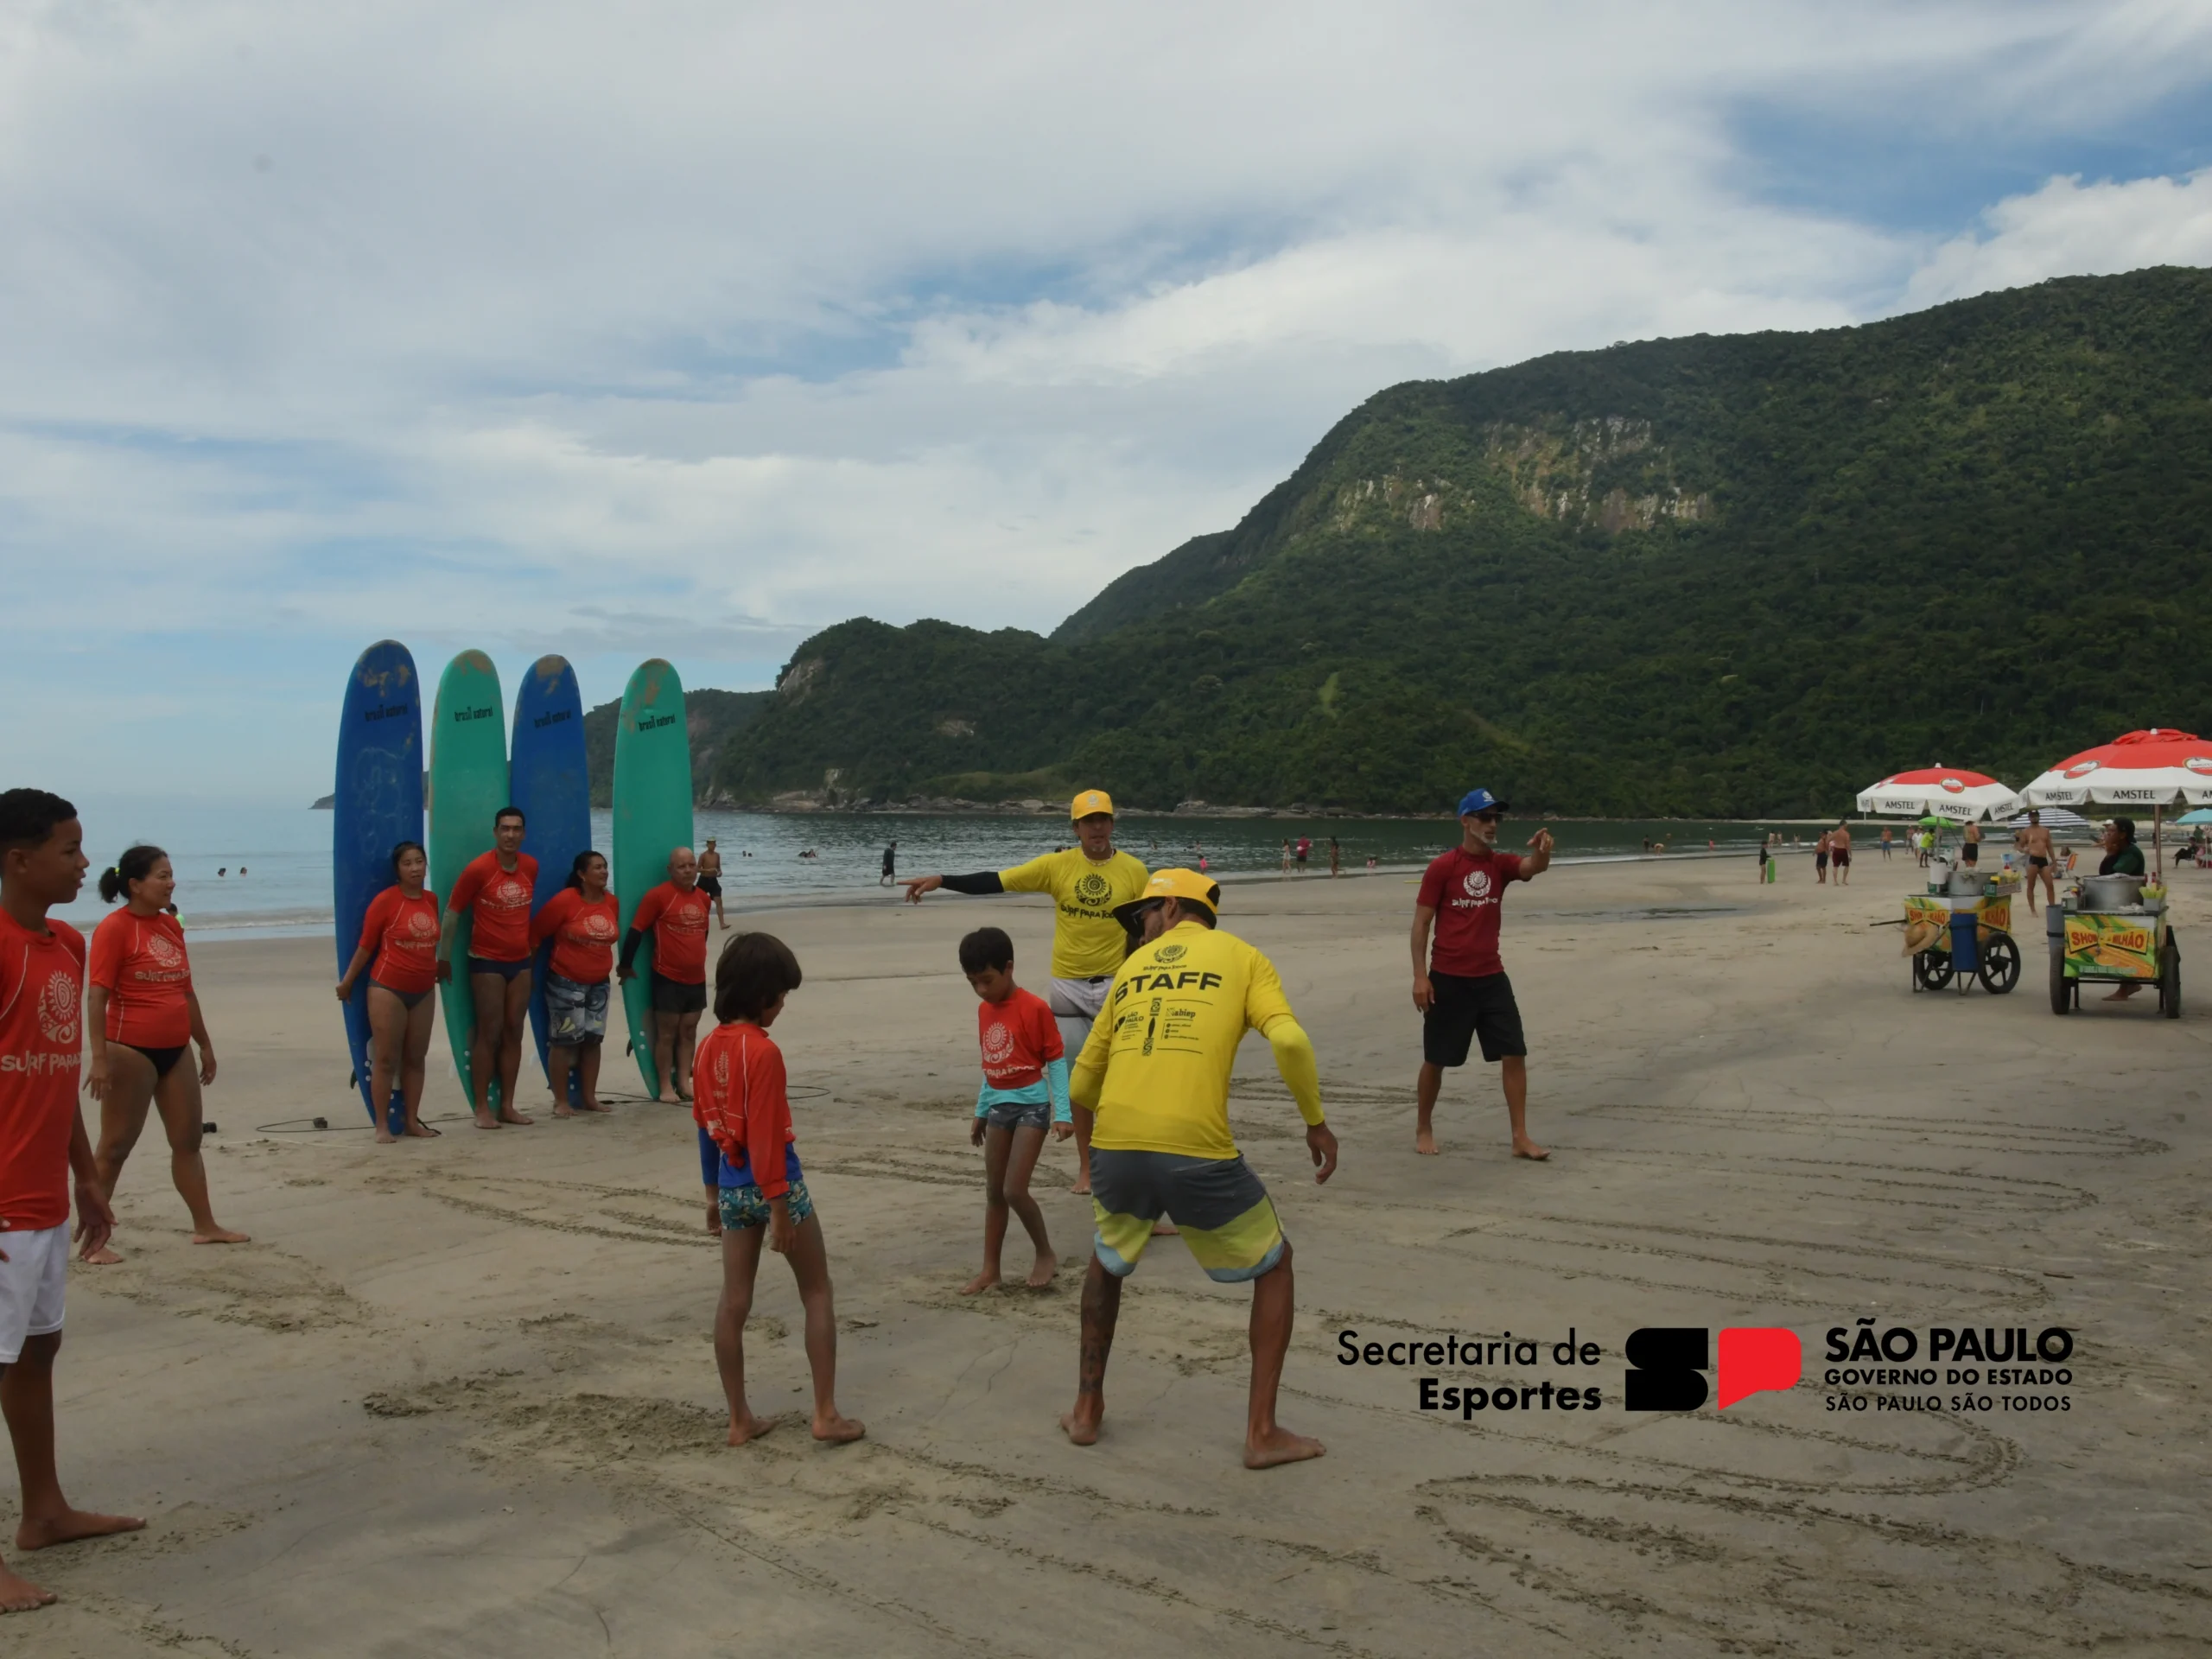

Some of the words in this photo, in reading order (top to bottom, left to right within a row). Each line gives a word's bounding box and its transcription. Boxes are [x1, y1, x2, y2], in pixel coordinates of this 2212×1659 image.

[2045, 791, 2074, 801] AMSTEL
[2113, 790, 2156, 799] AMSTEL
[1885, 801, 1916, 810] AMSTEL
[1939, 804, 1972, 817] AMSTEL
[1994, 802, 2014, 815] AMSTEL
[1060, 904, 1080, 917] SURF
[1080, 908, 1101, 919] PARA
[1115, 971, 1223, 1007] STAFF
[0, 1050, 48, 1077] SURF
